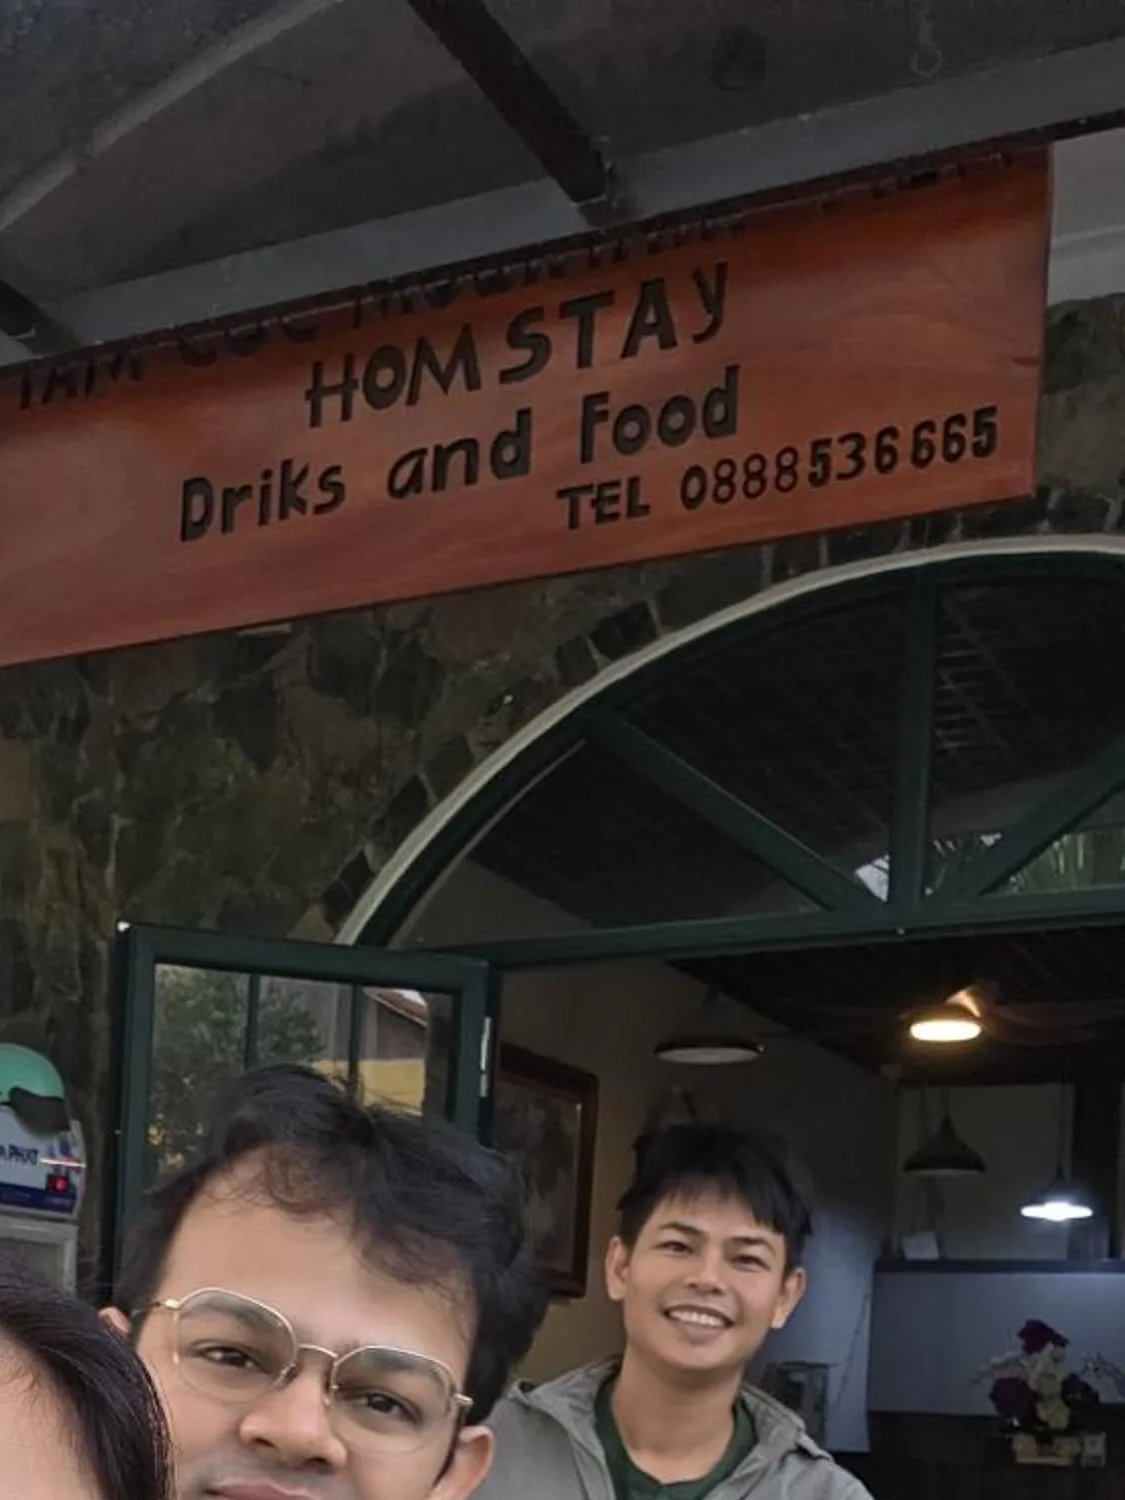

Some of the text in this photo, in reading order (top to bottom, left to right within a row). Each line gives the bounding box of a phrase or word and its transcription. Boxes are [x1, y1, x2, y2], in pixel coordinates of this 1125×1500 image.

[305, 262, 729, 428] HOMSTAY
[180, 364, 740, 542] Driks and Food
[556, 405, 998, 530] TEL 0888536665
